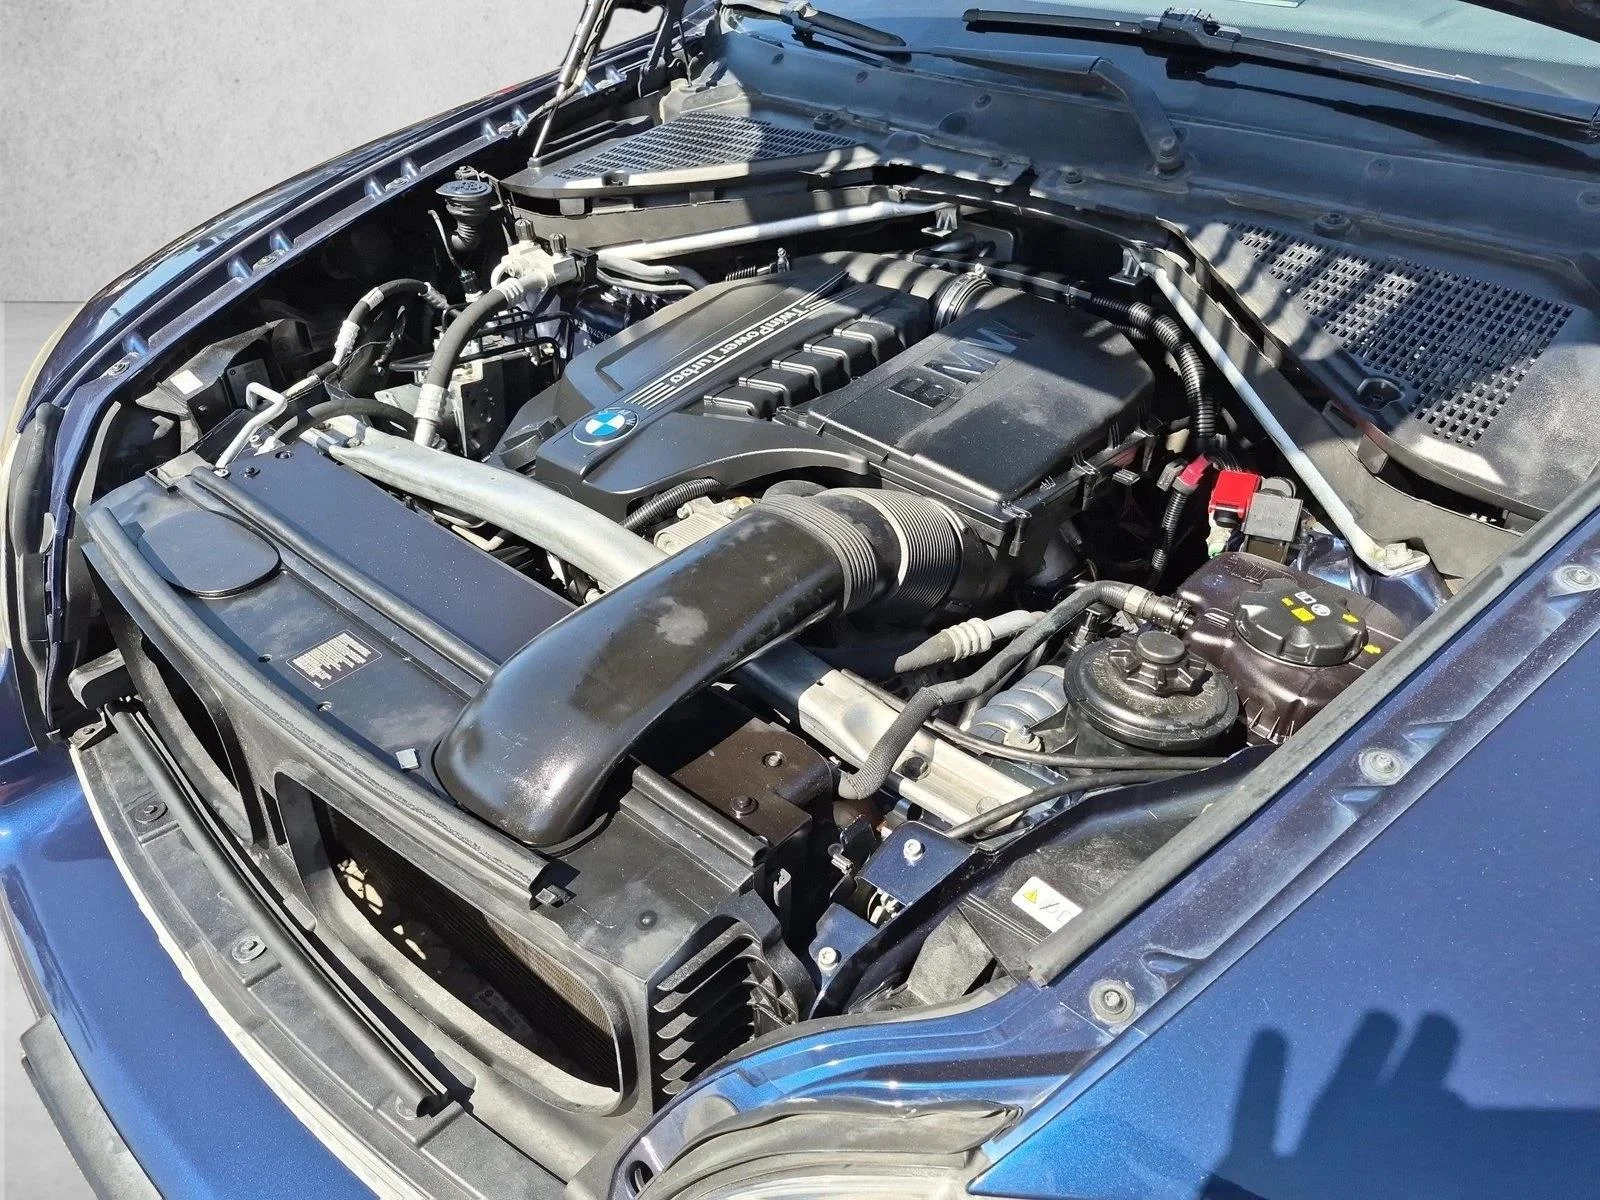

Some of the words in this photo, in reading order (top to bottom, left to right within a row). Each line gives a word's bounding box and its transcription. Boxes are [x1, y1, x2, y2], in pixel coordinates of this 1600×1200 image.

[722, 307, 810, 355] TwinPower
[669, 353, 726, 384] Turbo
[887, 318, 1035, 410] BMW
